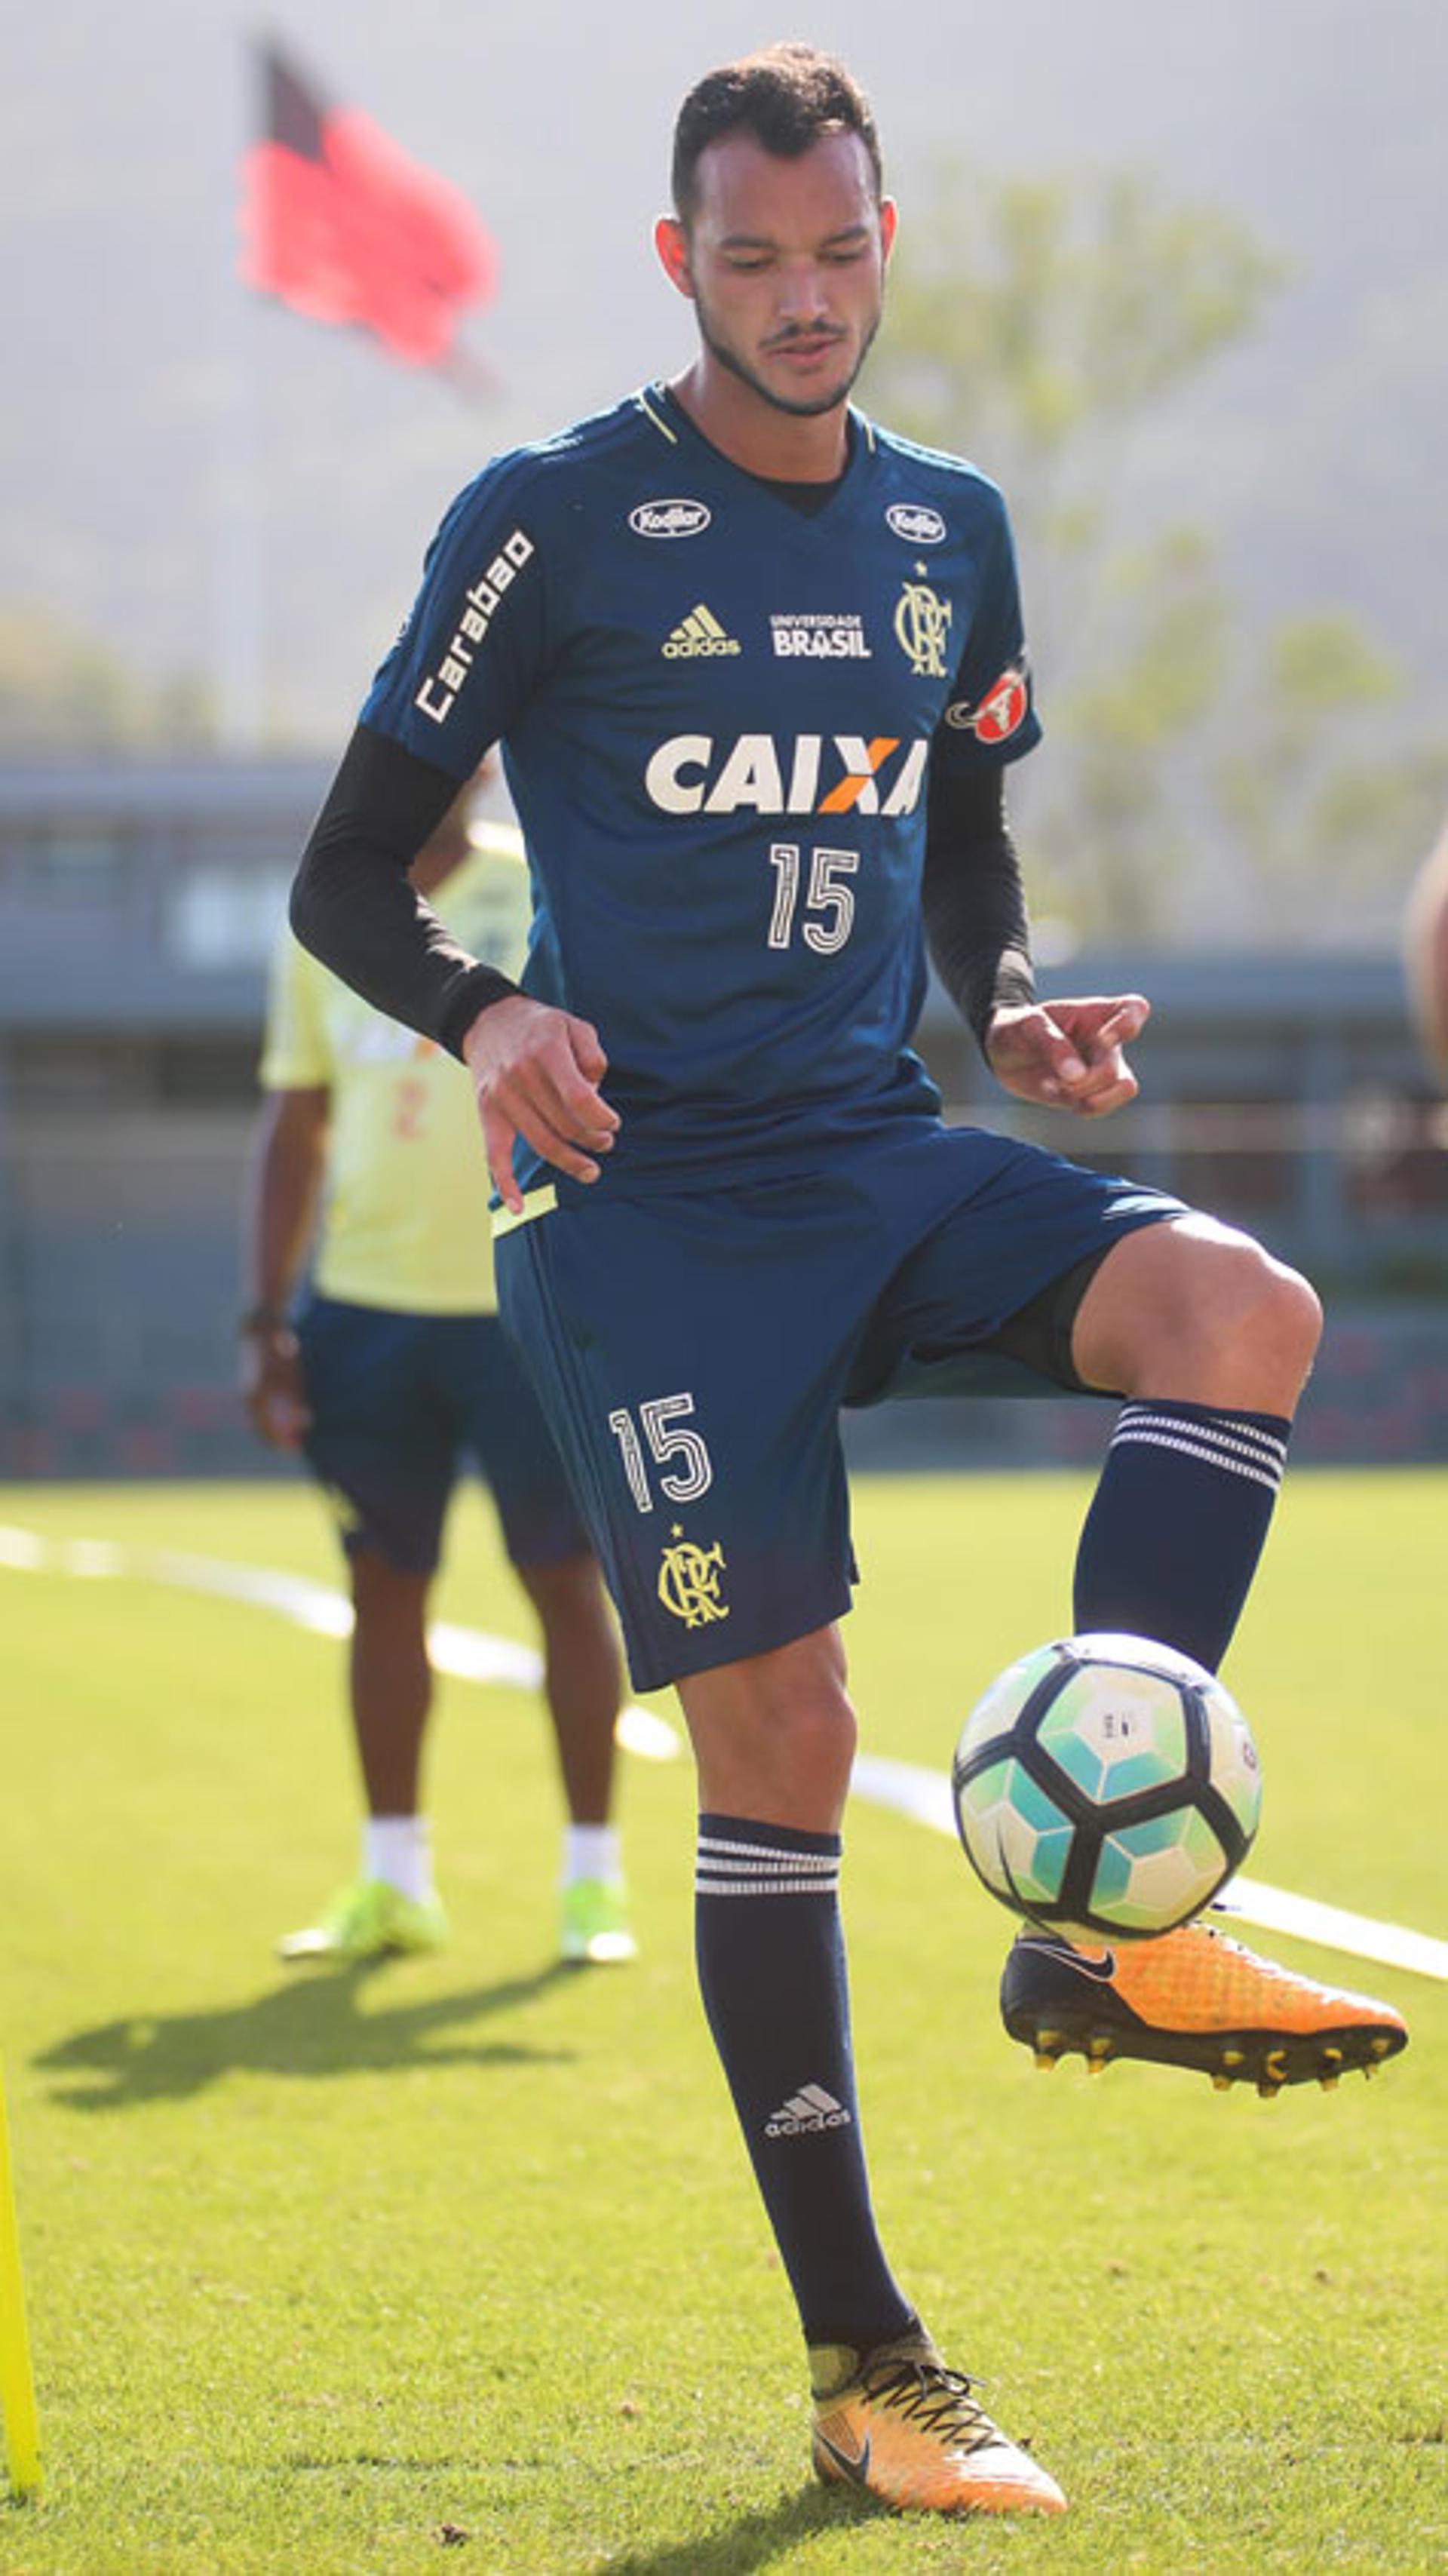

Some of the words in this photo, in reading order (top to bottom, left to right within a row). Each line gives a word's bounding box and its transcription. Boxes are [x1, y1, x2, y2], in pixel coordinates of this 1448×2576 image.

[415, 530, 535, 723] Carabao
[661, 637, 741, 659] adidas
[773, 630, 872, 659] BRASIL
[644, 734, 929, 816] CAIXA
[767, 843, 860, 955] 15
[609, 1392, 713, 1513] 15
[764, 2109, 852, 2138] adidas
